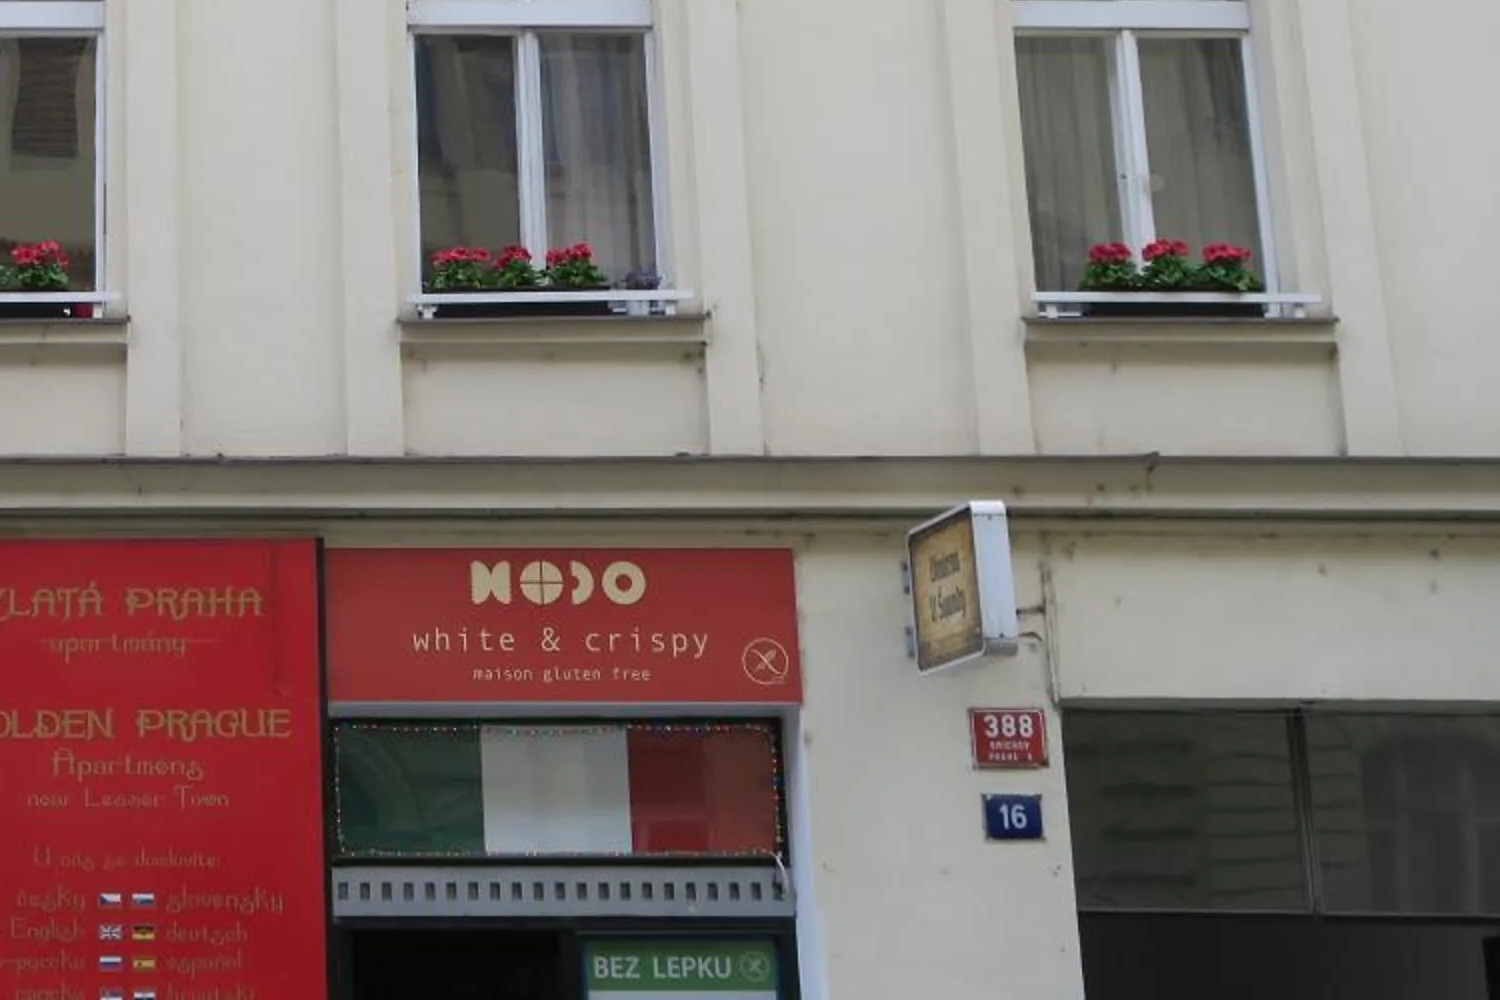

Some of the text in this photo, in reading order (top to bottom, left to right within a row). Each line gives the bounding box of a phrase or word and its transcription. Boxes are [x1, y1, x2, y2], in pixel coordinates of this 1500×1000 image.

[125, 587, 264, 620] PRAHA
[412, 627, 709, 658] white & crispy
[472, 666, 652, 683] maison gluten free
[137, 709, 294, 742] PRAGUE
[983, 714, 1034, 738] 388
[174, 784, 230, 811] Town
[999, 803, 1028, 830] 16
[593, 955, 732, 980] BEZ LEPKU
